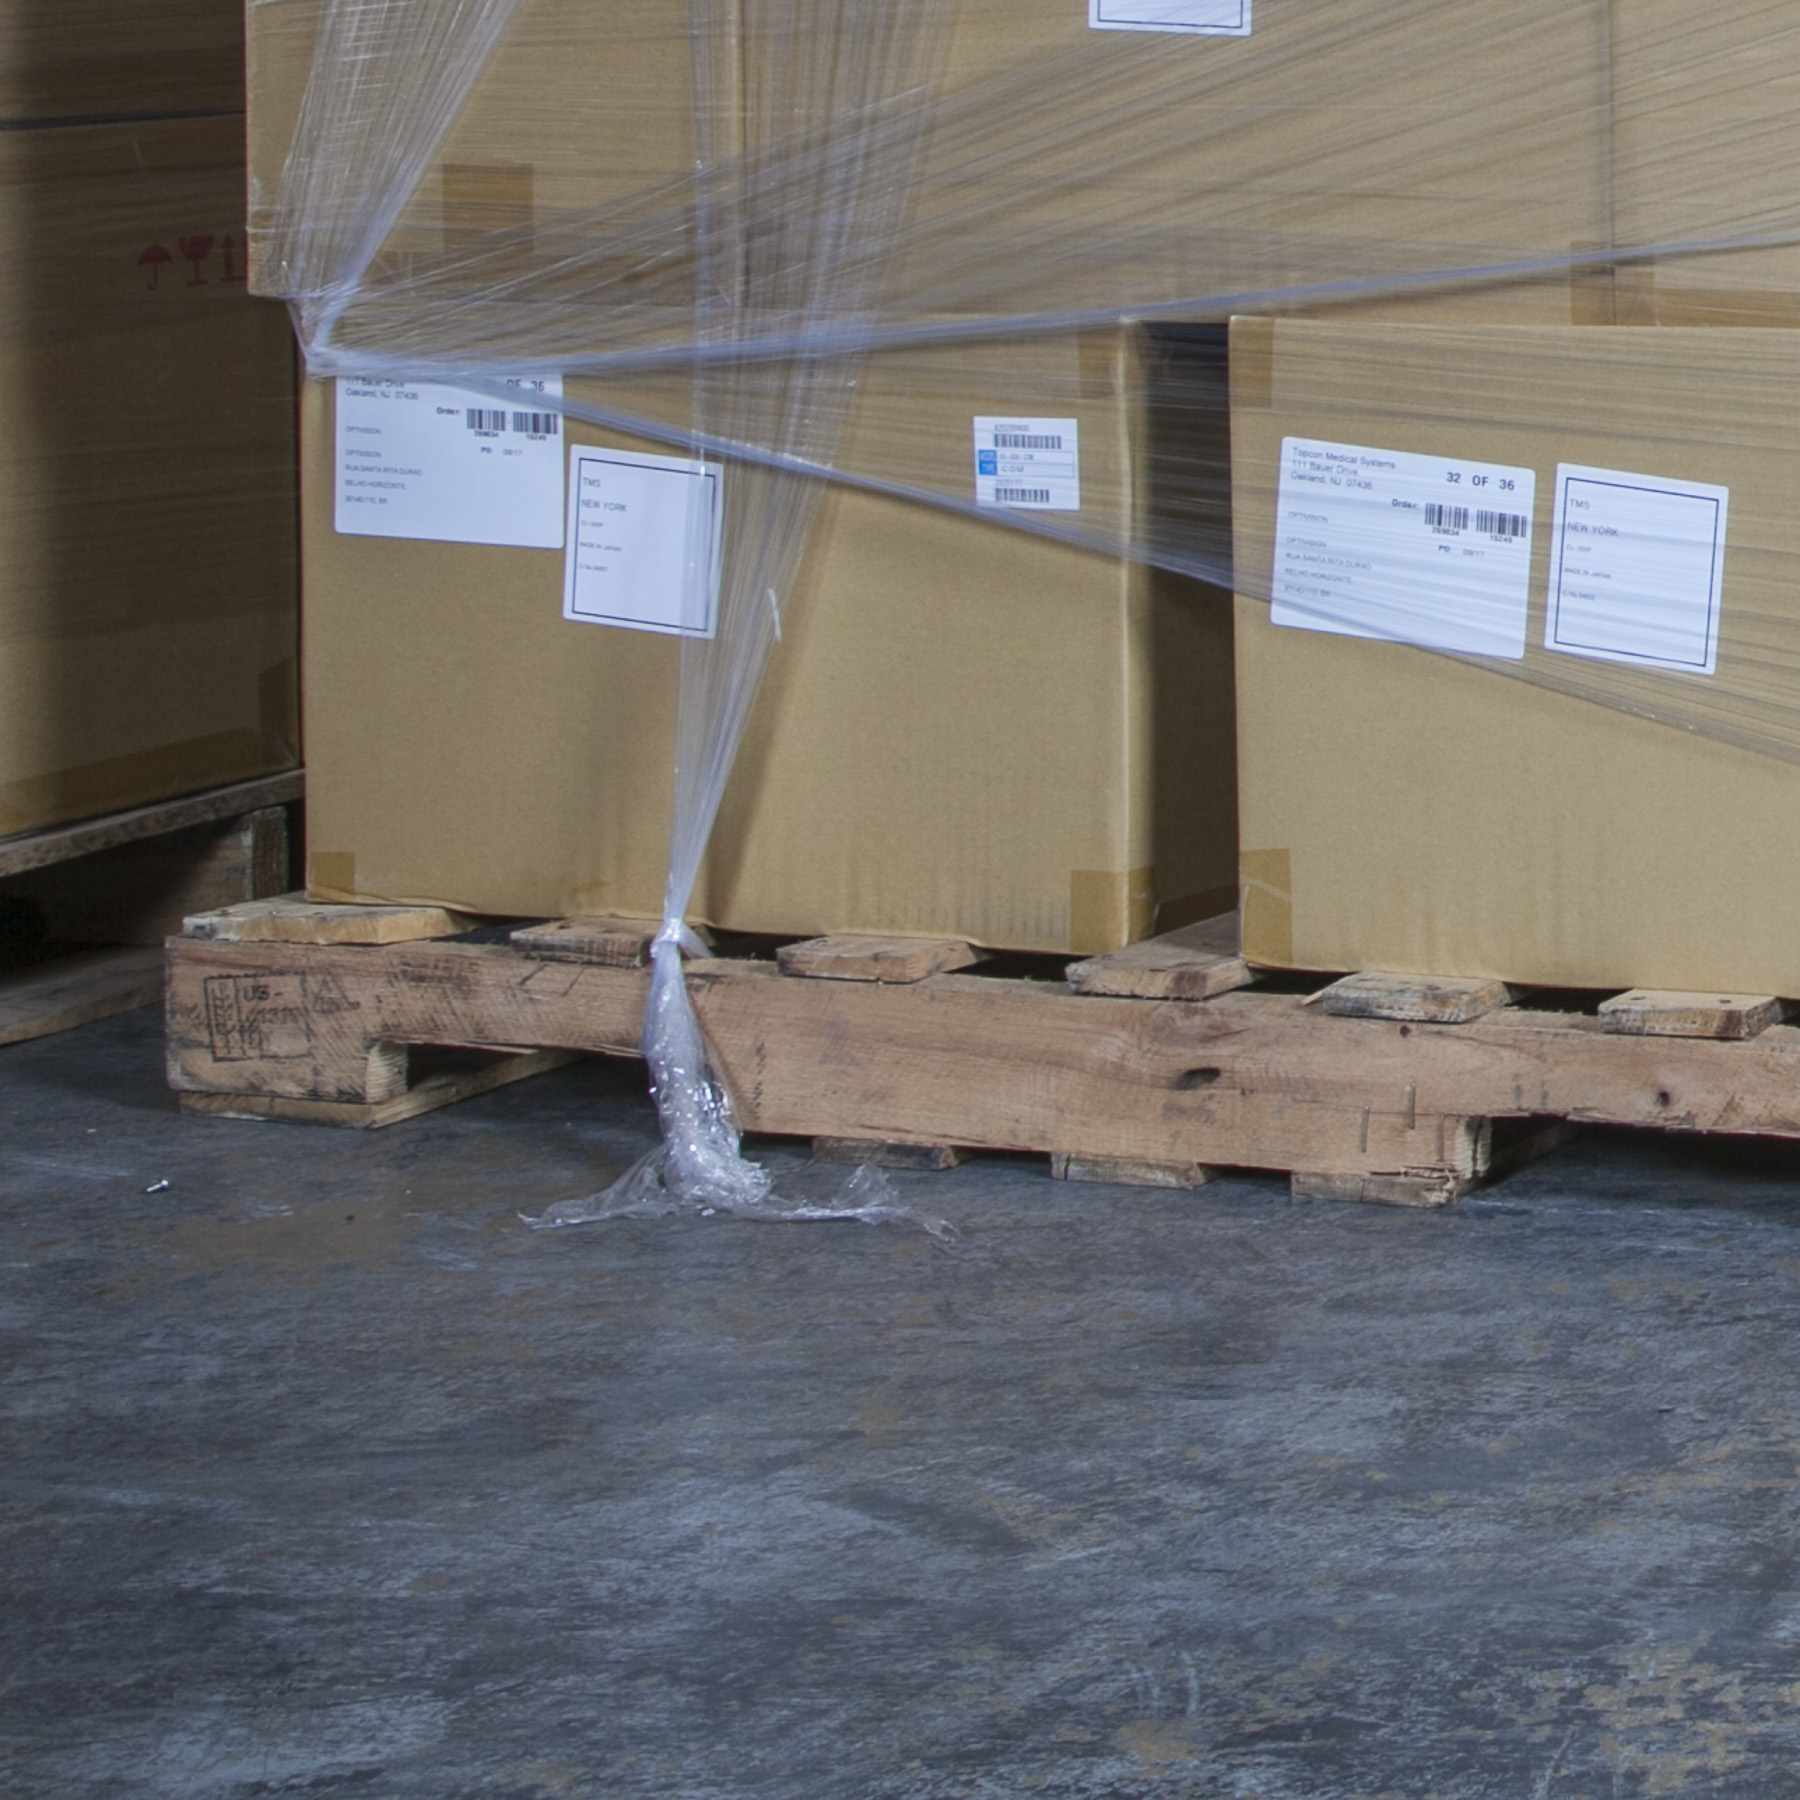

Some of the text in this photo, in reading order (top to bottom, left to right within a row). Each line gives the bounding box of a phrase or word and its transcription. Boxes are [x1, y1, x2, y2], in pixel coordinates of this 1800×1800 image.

[531, 382, 544, 392] 36
[1292, 459, 1358, 476] 111 Bauer Drive
[1292, 447, 1515, 490] Topcon Medical Systems 32 OF 36
[583, 478, 601, 487] TMS
[1330, 477, 1341, 486] NJ
[582, 500, 627, 512] NEW YORK
[1570, 499, 1590, 510] TMS
[1568, 522, 1619, 537] NEW YORK
